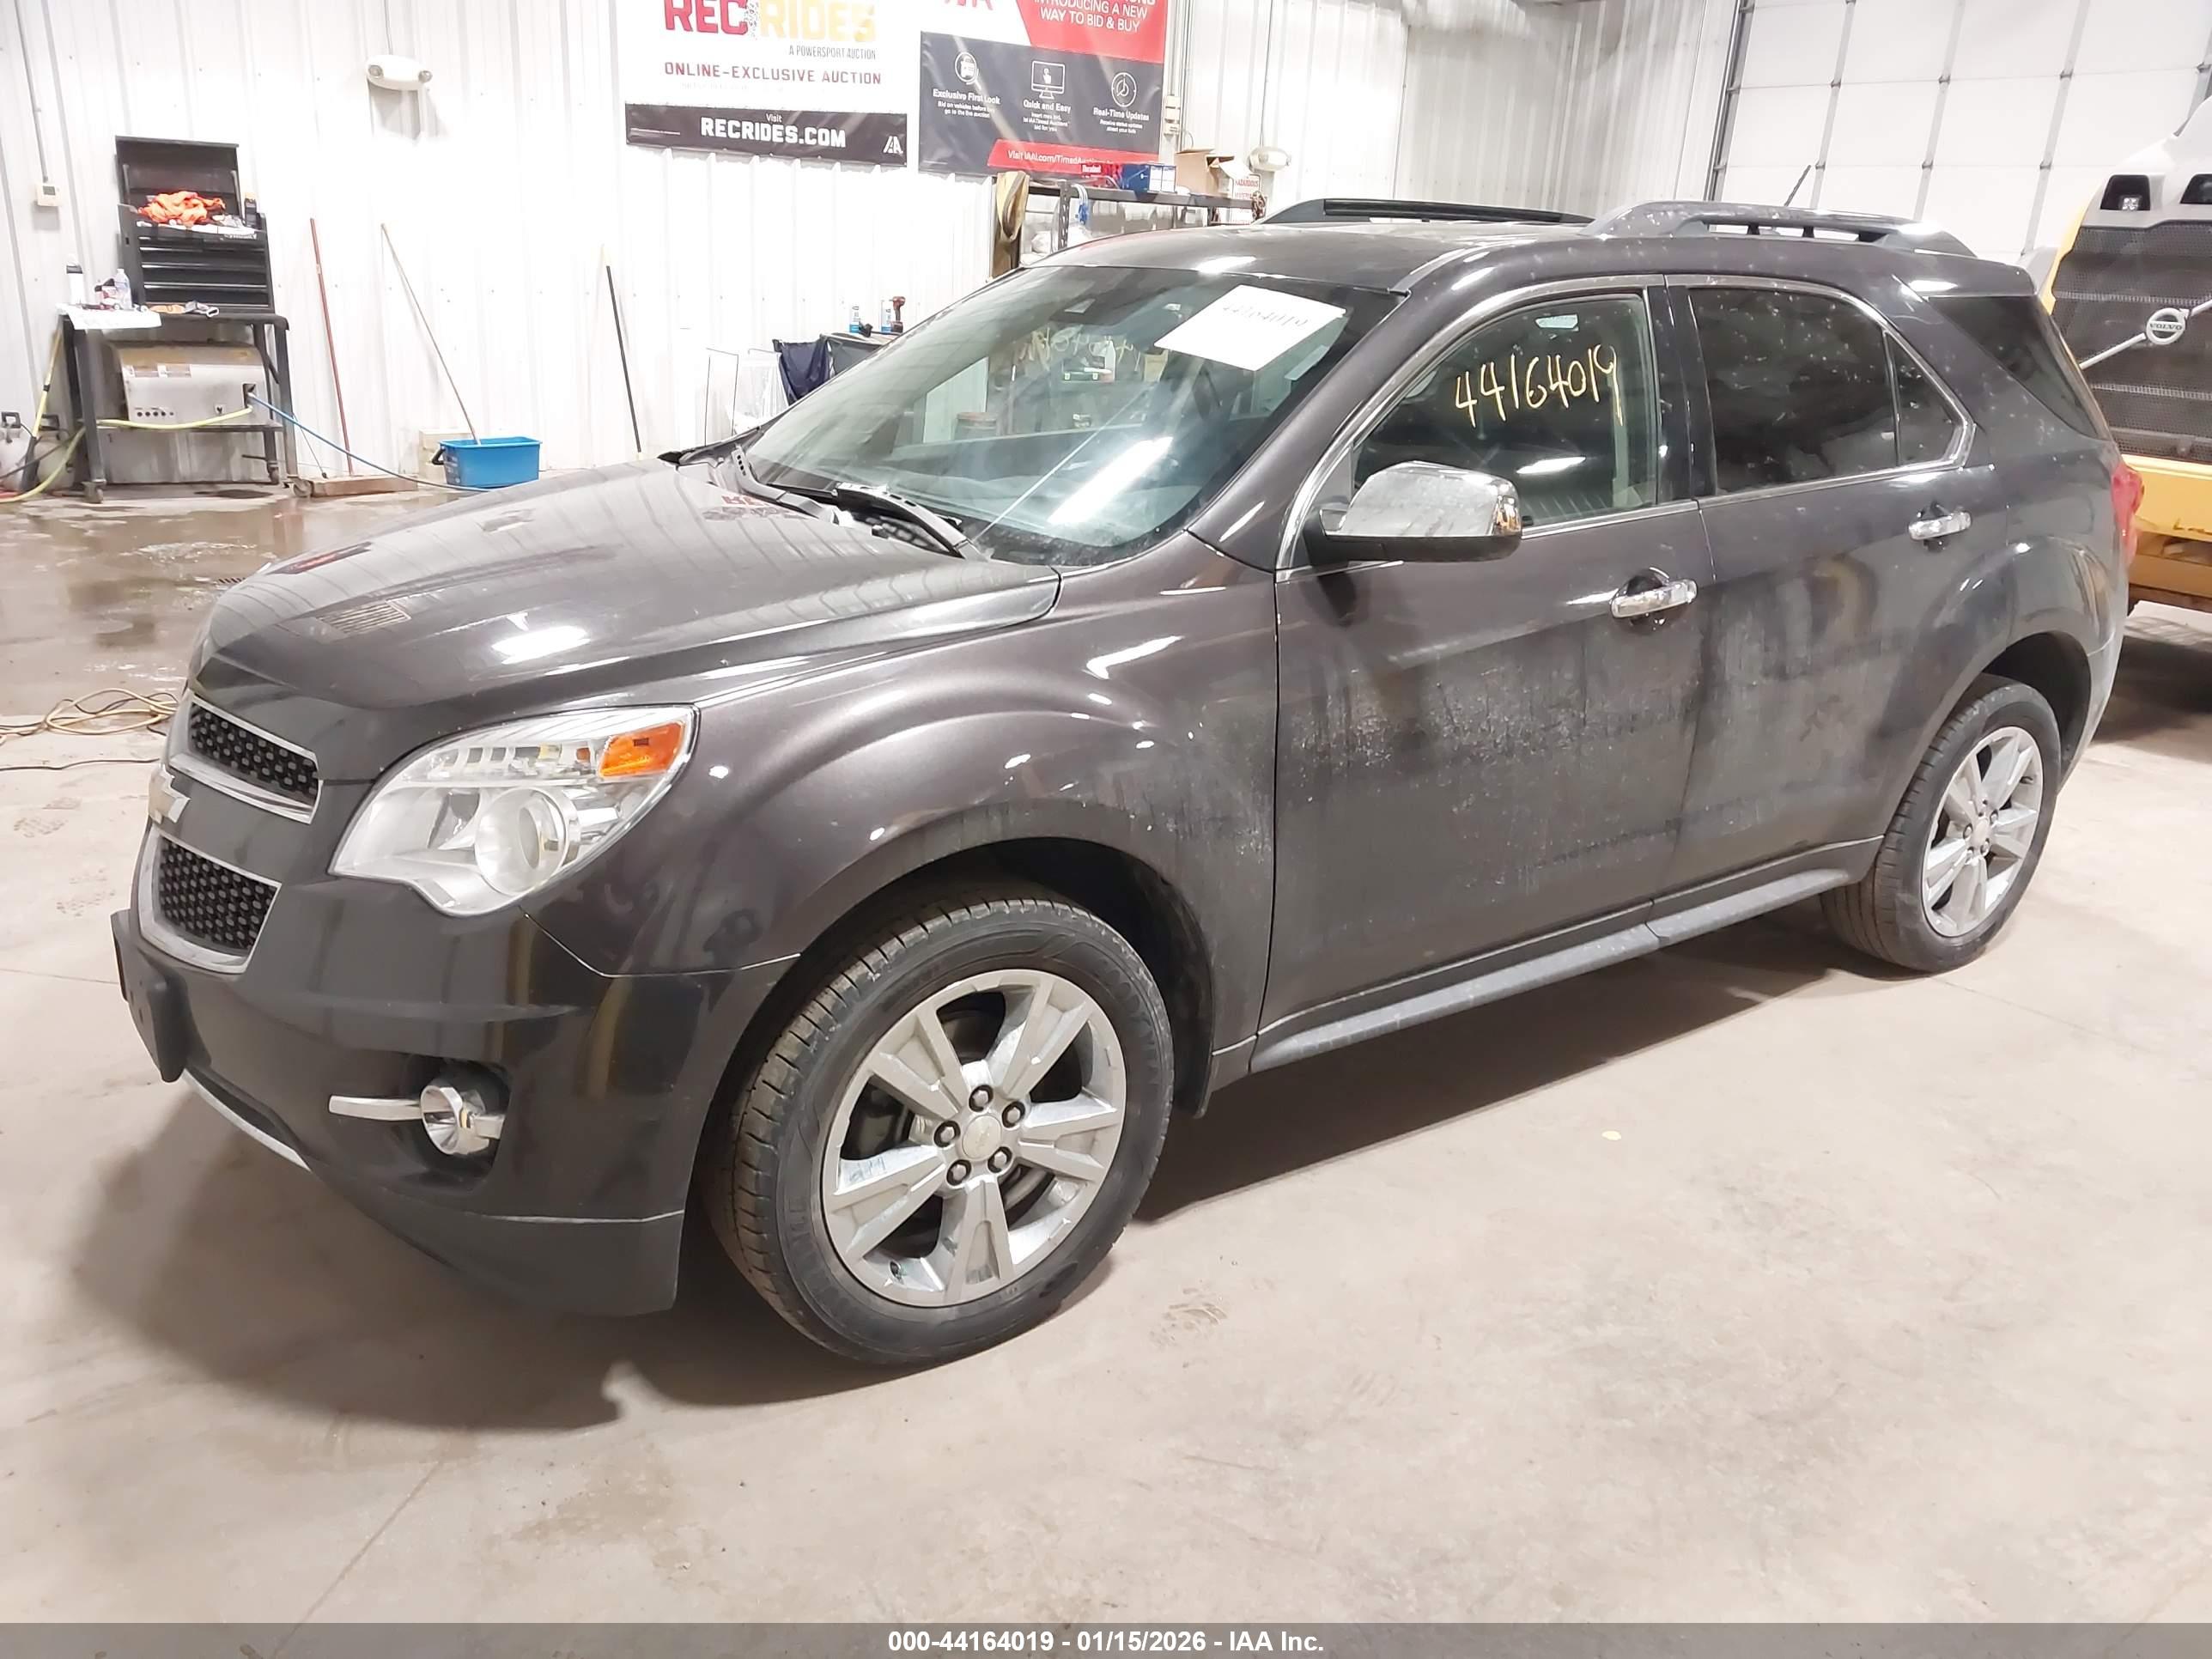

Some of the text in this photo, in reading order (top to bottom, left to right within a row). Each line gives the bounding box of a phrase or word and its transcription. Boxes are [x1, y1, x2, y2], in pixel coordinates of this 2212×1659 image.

[1040, 7, 1140, 33] WAY TO BID & BUY
[1112, 3, 1120, 15] A
[1122, 3, 1148, 21] NEW
[665, 0, 876, 42] REC RIDES
[788, 45, 876, 60] A POWERSPORT AUCTION
[665, 62, 882, 85] ONLINE-EXCLUSIVE AUCTION
[933, 88, 1000, 105] Exclusive First Look
[1023, 99, 1072, 114] Quick and Easy
[1093, 106, 1149, 121] Real-Time Updates
[766, 113, 782, 123] Visit
[701, 117, 847, 149] RECRIDES.COM
[1007, 150, 1023, 161] Visit
[2148, 323, 2183, 331] VOLVO
[1455, 343, 1624, 428] 44164019
